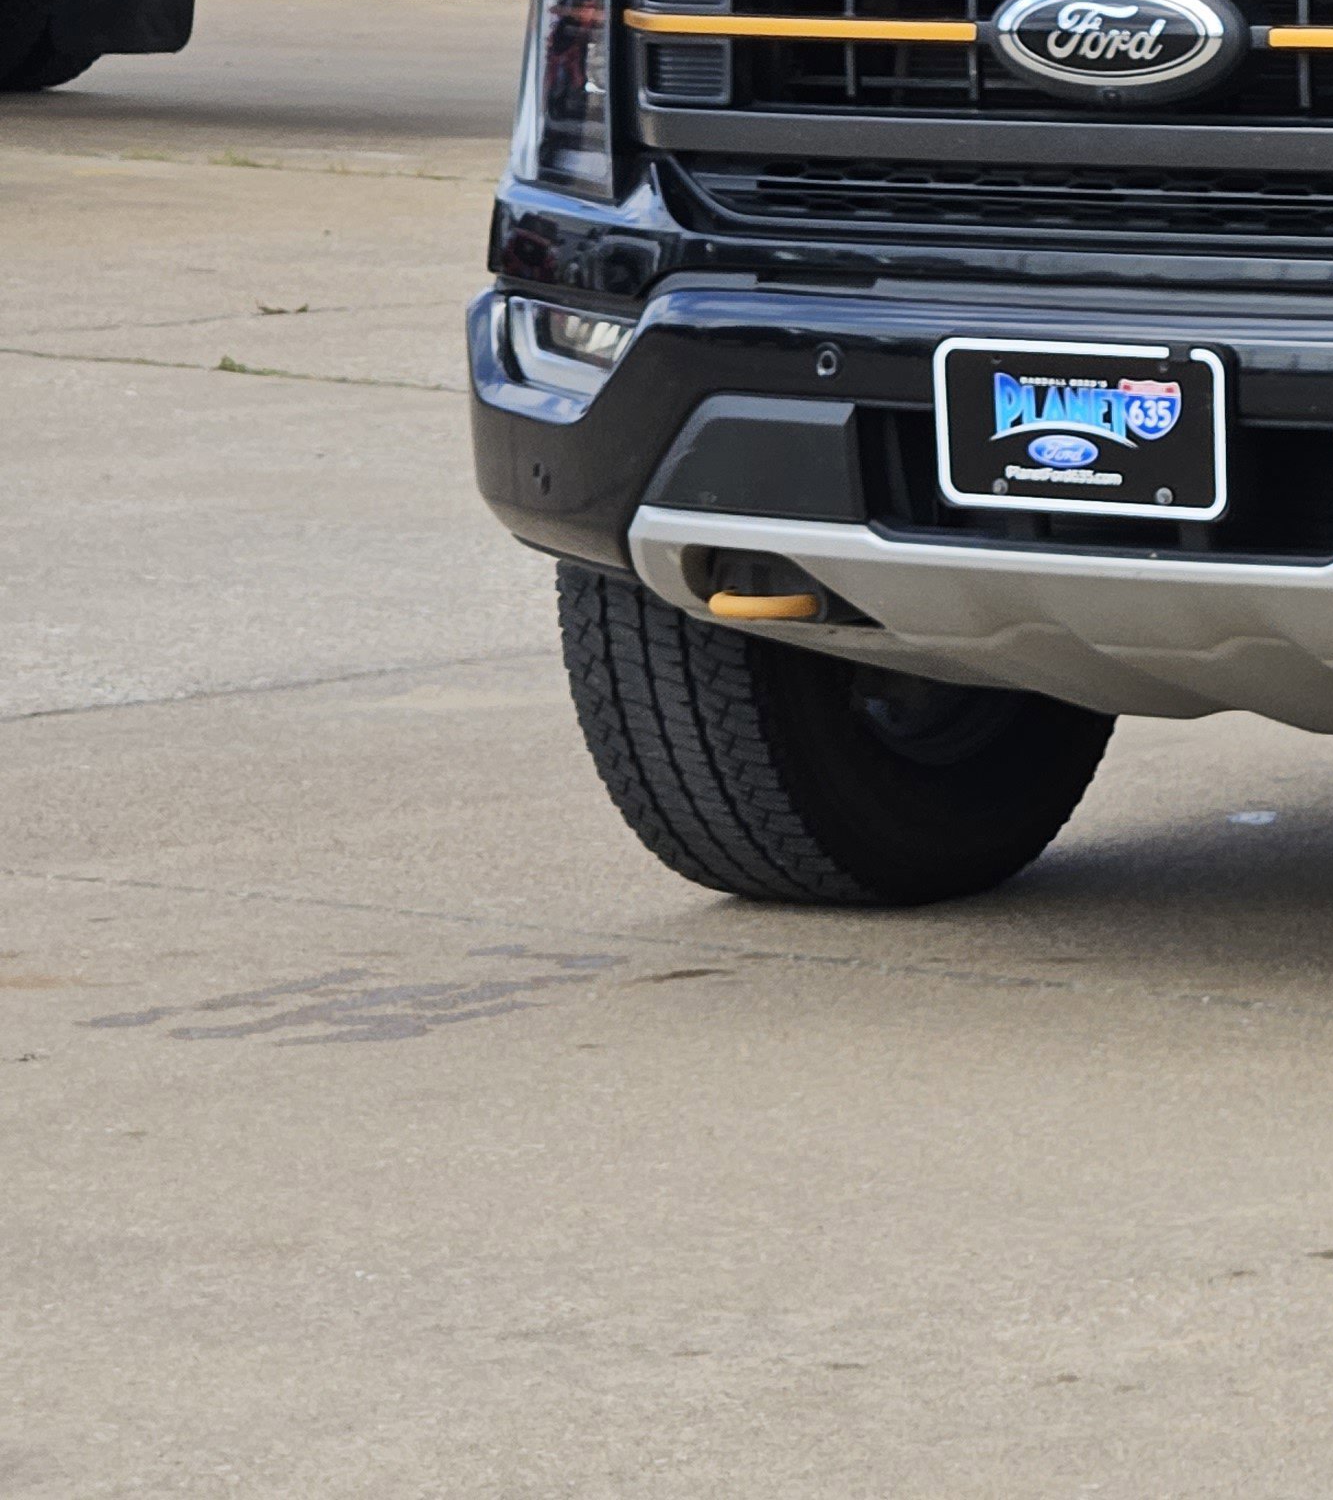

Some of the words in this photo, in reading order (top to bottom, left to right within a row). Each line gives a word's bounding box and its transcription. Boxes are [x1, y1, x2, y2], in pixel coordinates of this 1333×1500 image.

[1047, 1, 1167, 60] Ford
[993, 372, 1128, 438] PLANET
[1129, 400, 1172, 428] 635
